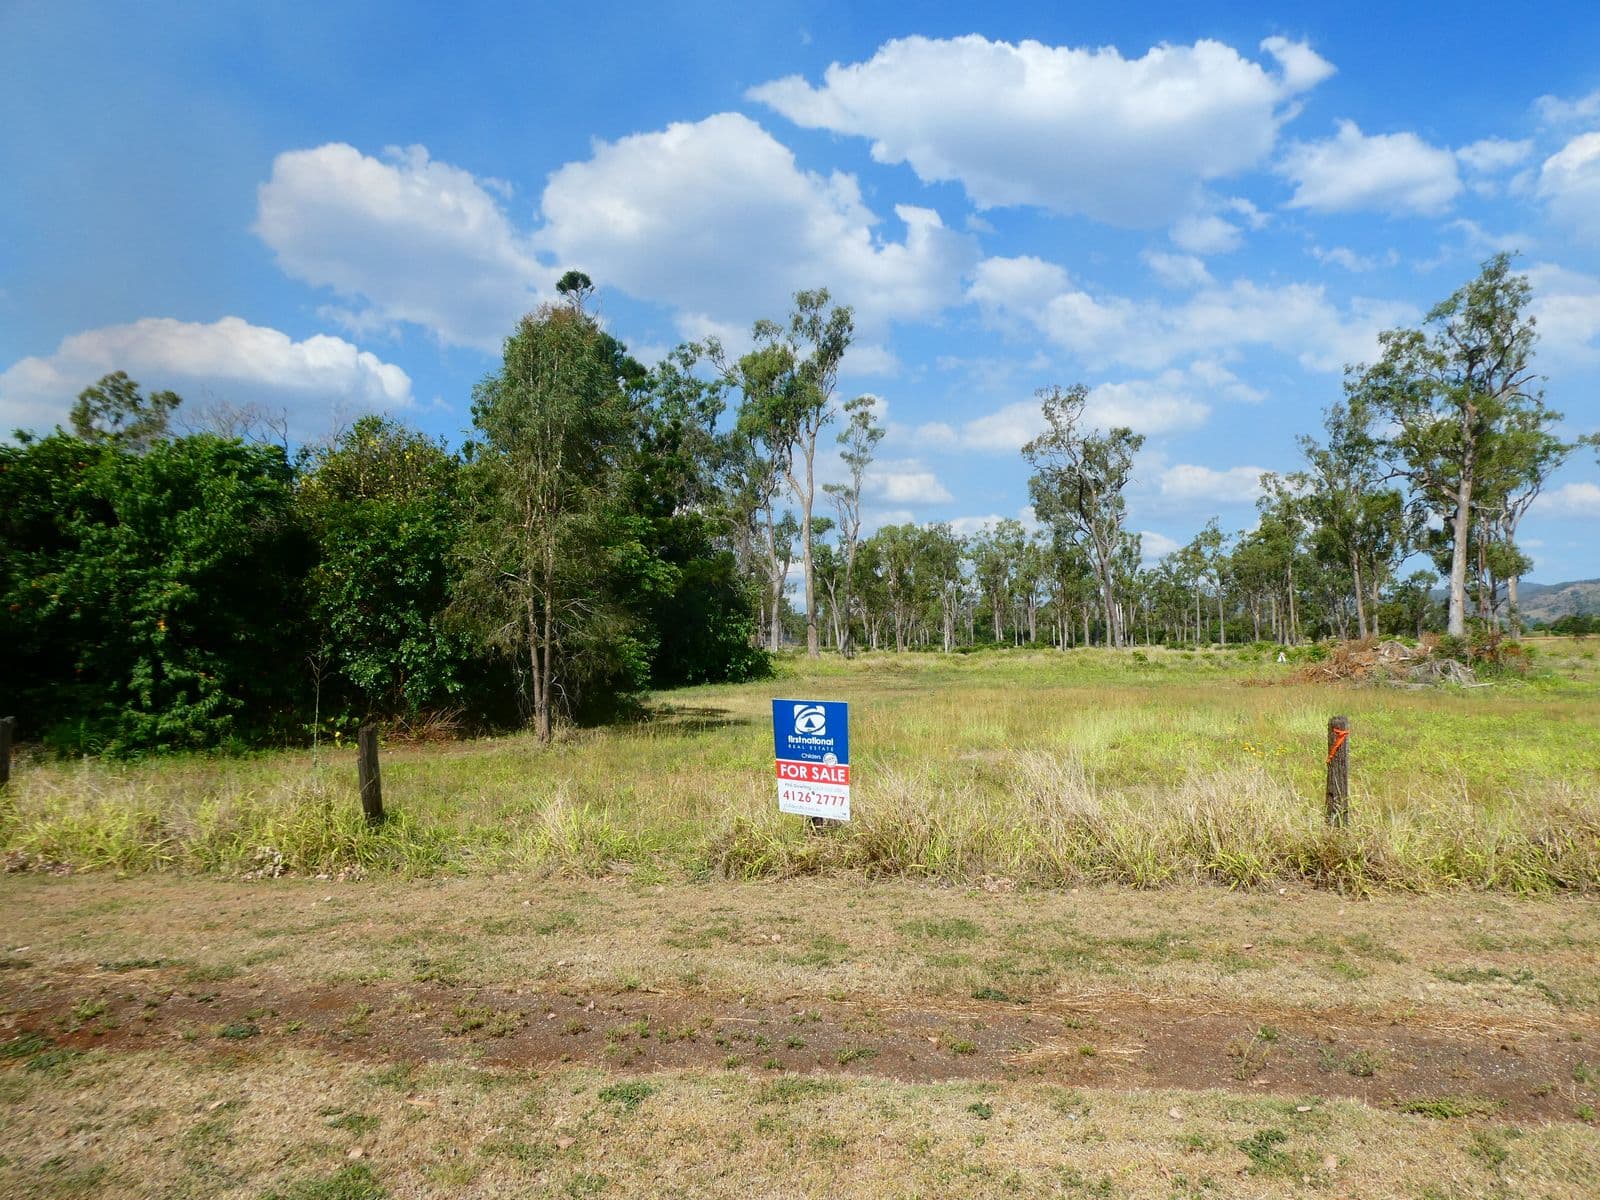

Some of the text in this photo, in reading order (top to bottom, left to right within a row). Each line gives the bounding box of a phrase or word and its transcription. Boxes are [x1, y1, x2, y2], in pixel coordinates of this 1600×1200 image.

[780, 764, 846, 783] FOR SALE
[783, 790, 845, 807] 4126 2777
